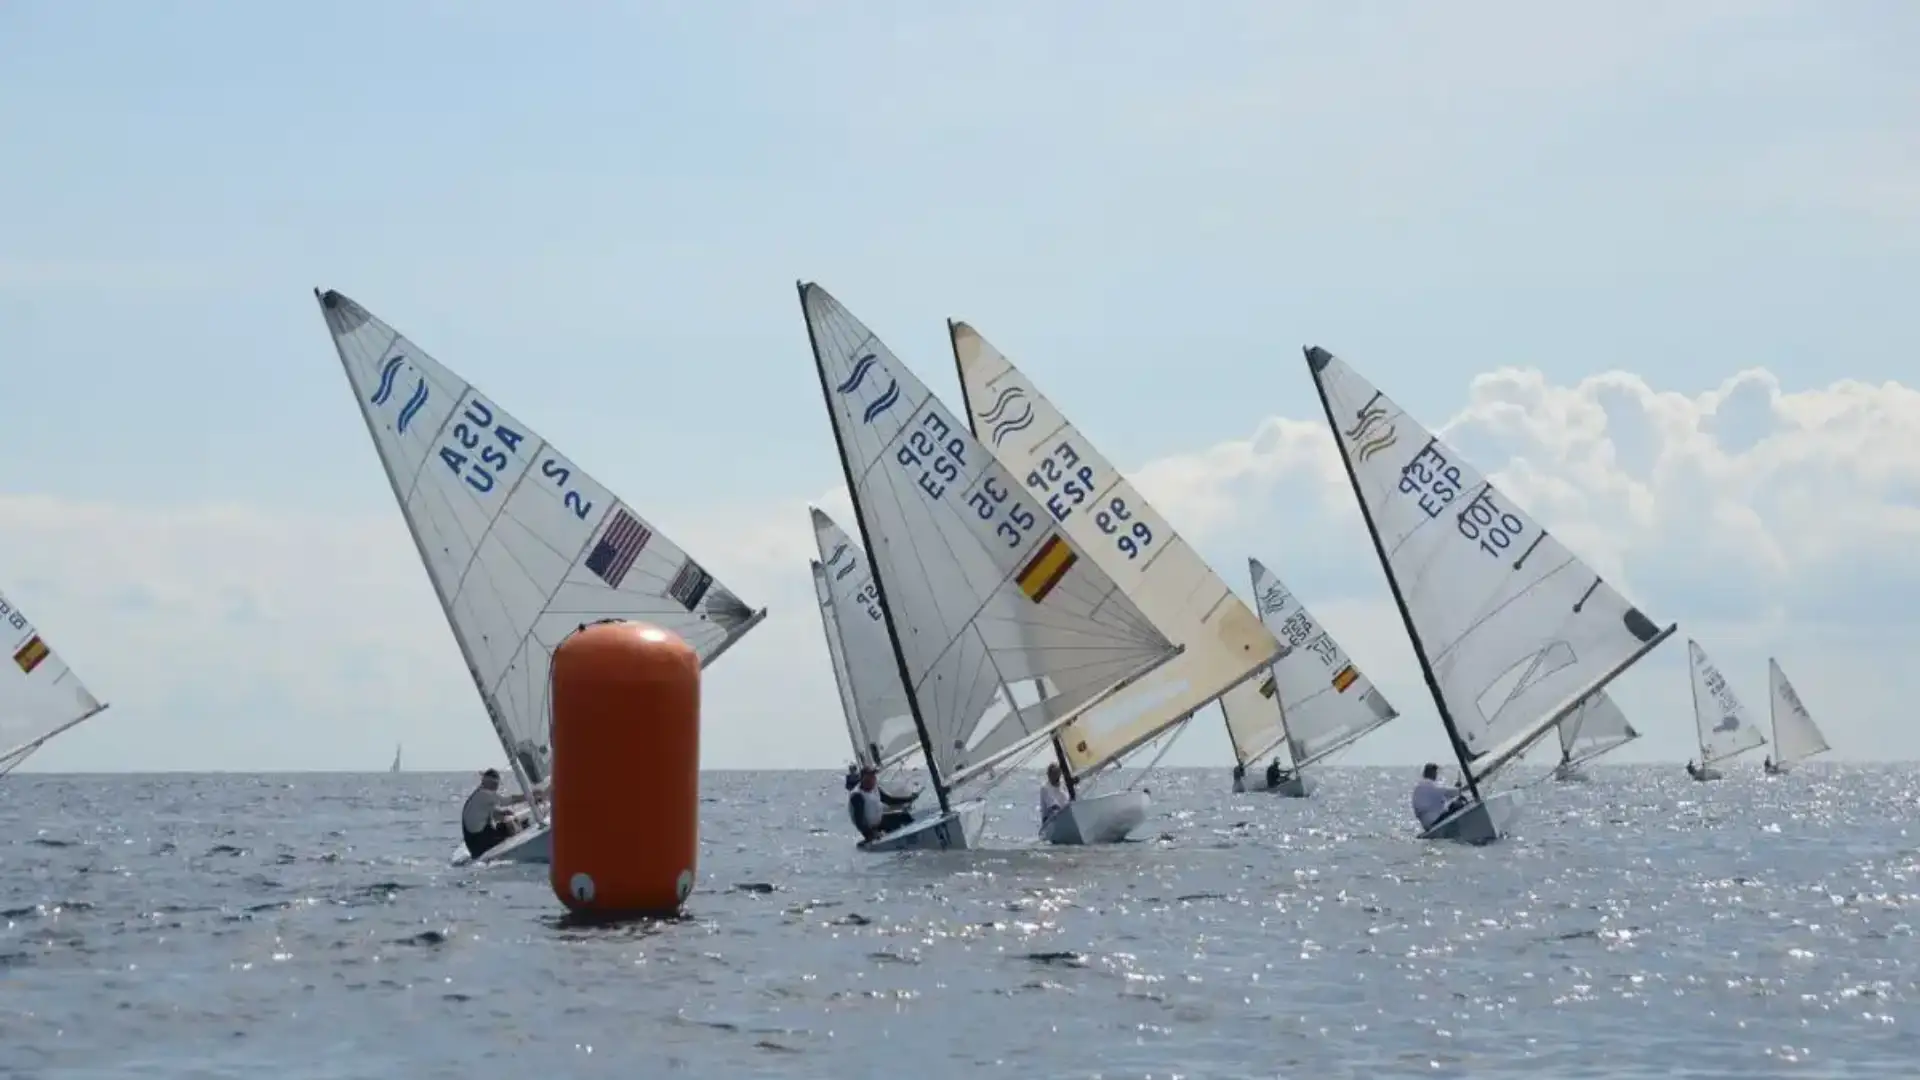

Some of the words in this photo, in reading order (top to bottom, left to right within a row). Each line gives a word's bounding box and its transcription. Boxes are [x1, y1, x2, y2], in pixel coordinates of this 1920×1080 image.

[465, 425, 524, 493] USA
[918, 438, 966, 501] ESP
[564, 490, 592, 520] 2
[1046, 466, 1095, 522] ESP
[1418, 466, 1462, 518] ESP
[997, 502, 1035, 548] 35
[1117, 522, 1152, 560] 99
[1480, 513, 1523, 557] 100
